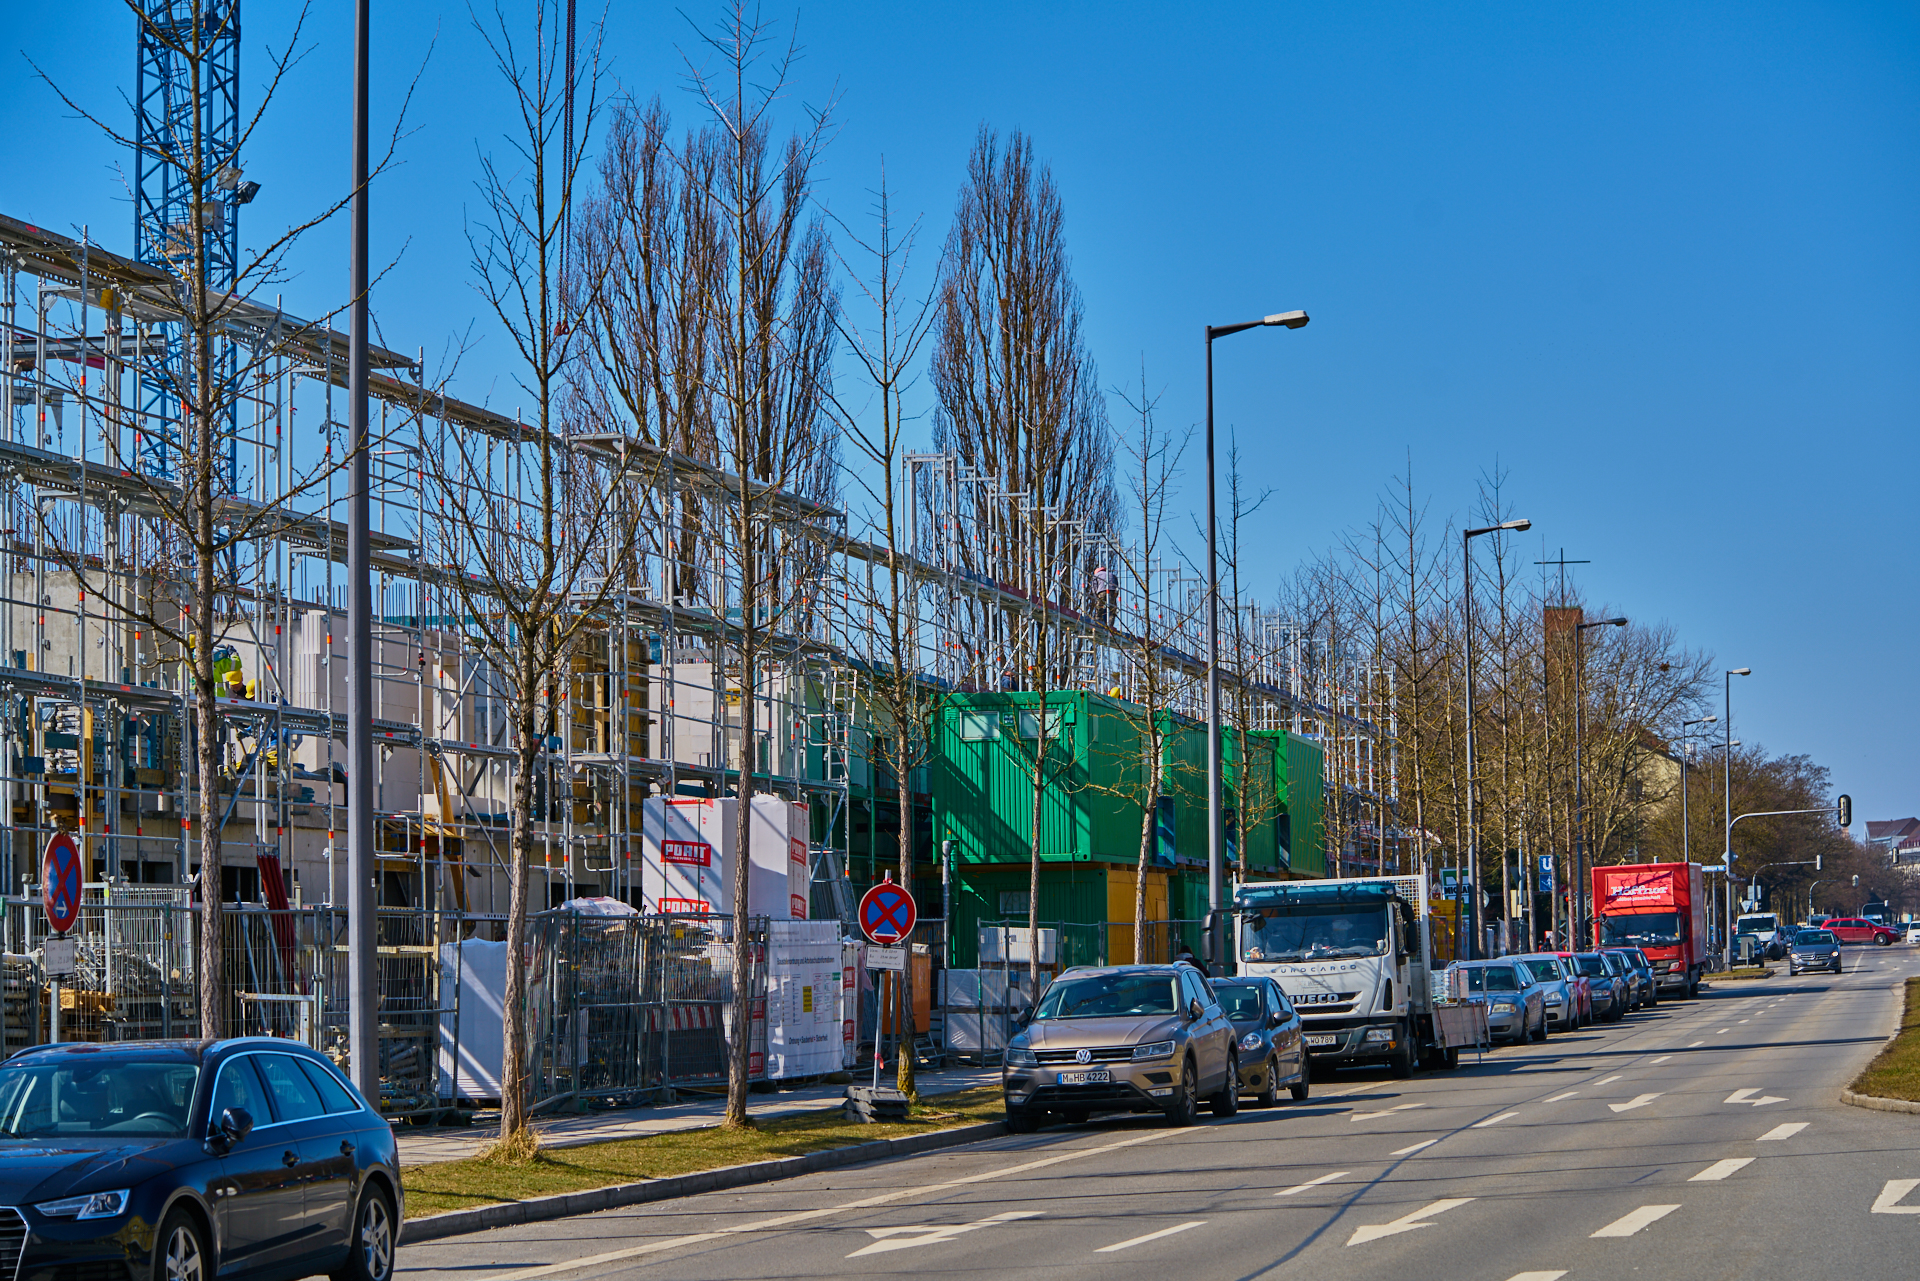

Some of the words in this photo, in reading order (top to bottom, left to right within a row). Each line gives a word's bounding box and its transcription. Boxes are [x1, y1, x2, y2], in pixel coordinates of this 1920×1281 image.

[666, 843, 706, 859] PORIT
[1543, 858, 1552, 871] U
[1611, 884, 1668, 896] Höffner
[1270, 964, 1358, 974] EUROCARGO
[1290, 993, 1340, 1005] IVECO
[1321, 1036, 1334, 1044] 789
[1062, 1073, 1069, 1083] M
[1073, 1072, 1086, 1082] HB
[1086, 1071, 1109, 1082] 4222
